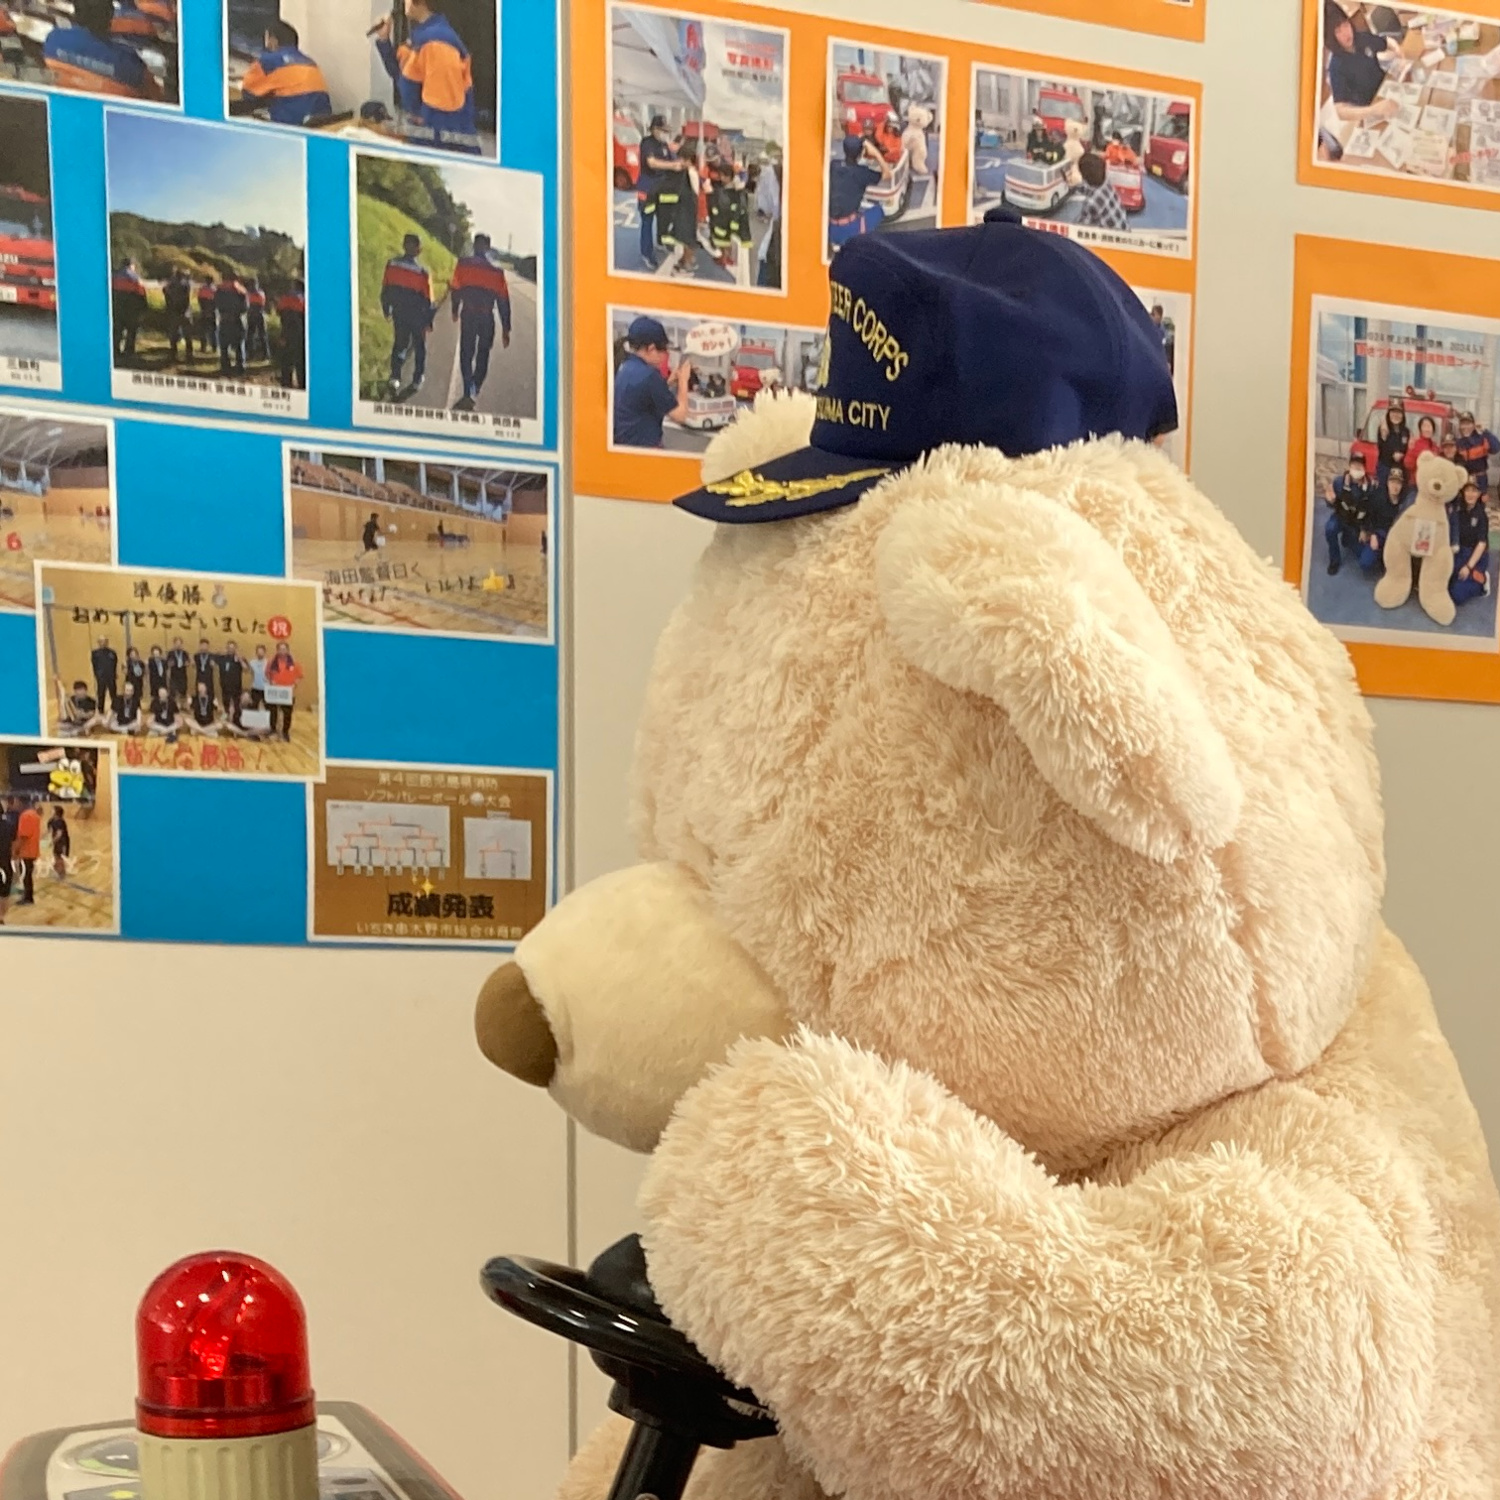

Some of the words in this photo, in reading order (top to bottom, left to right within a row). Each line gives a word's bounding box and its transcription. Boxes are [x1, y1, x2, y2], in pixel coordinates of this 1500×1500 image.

[852, 297, 909, 382] CORPS
[848, 400, 890, 431] CITY
[133, 581, 205, 605] 準優勝
[72, 606, 267, 635] おめでとうございました
[387, 892, 495, 918] 成績発表
